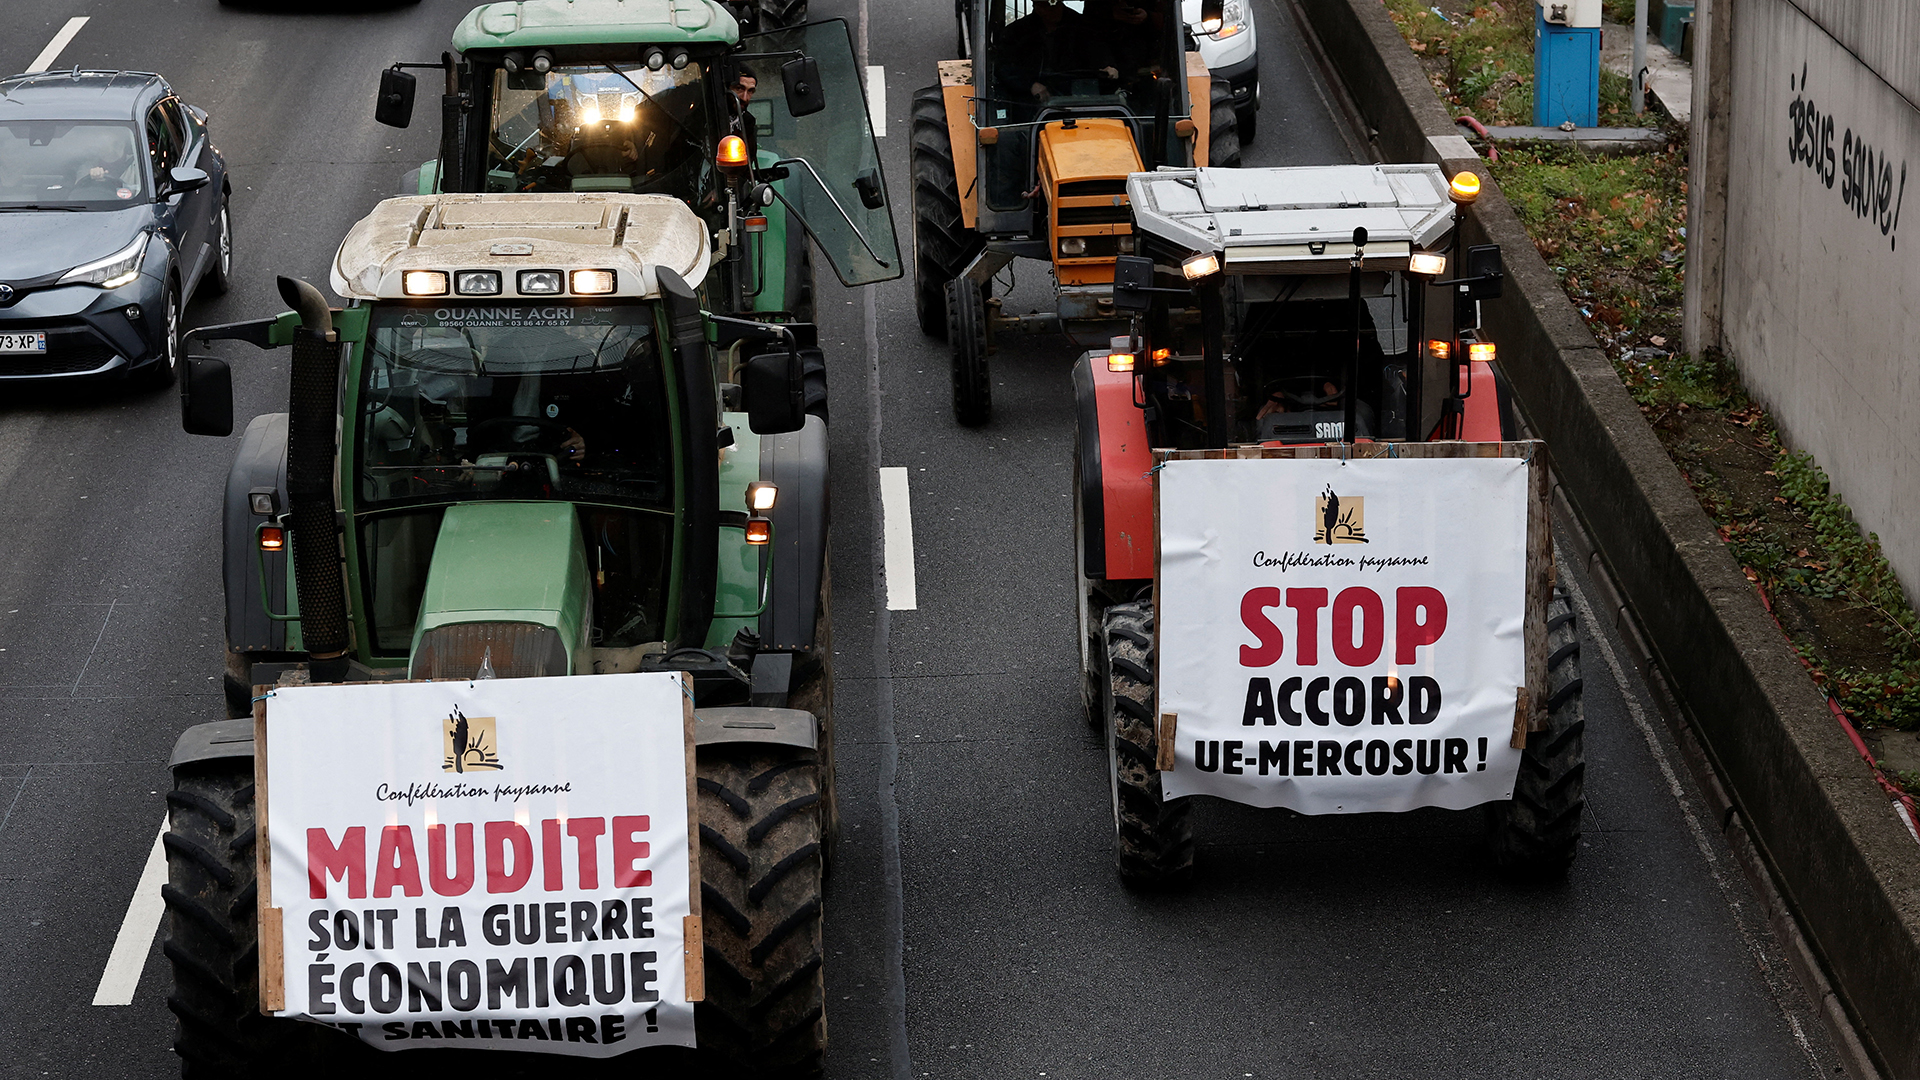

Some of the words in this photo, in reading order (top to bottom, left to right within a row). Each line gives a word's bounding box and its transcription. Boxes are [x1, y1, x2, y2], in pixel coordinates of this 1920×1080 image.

[434, 308, 522, 321] OUANNE
[527, 307, 575, 320] AGRI
[1315, 422, 1345, 439] SAM
[1253, 550, 1355, 573] Confédération
[1359, 554, 1429, 573] paysanne
[1239, 586, 1448, 668] STOP
[1242, 676, 1442, 727] ACCORD
[1194, 738, 1469, 777] UE-MERCOSUR
[376, 782, 489, 807] Confédération
[493, 782, 572, 802] paysanne
[306, 815, 653, 900] MAUDITE
[308, 909, 398, 951] SOIT
[415, 906, 467, 949] LA
[482, 897, 655, 945] GUERRE
[308, 951, 660, 1015] ÉCONOMIQUE
[384, 1016, 627, 1045] SANITAIRE
[646, 1008, 660, 1033] !
